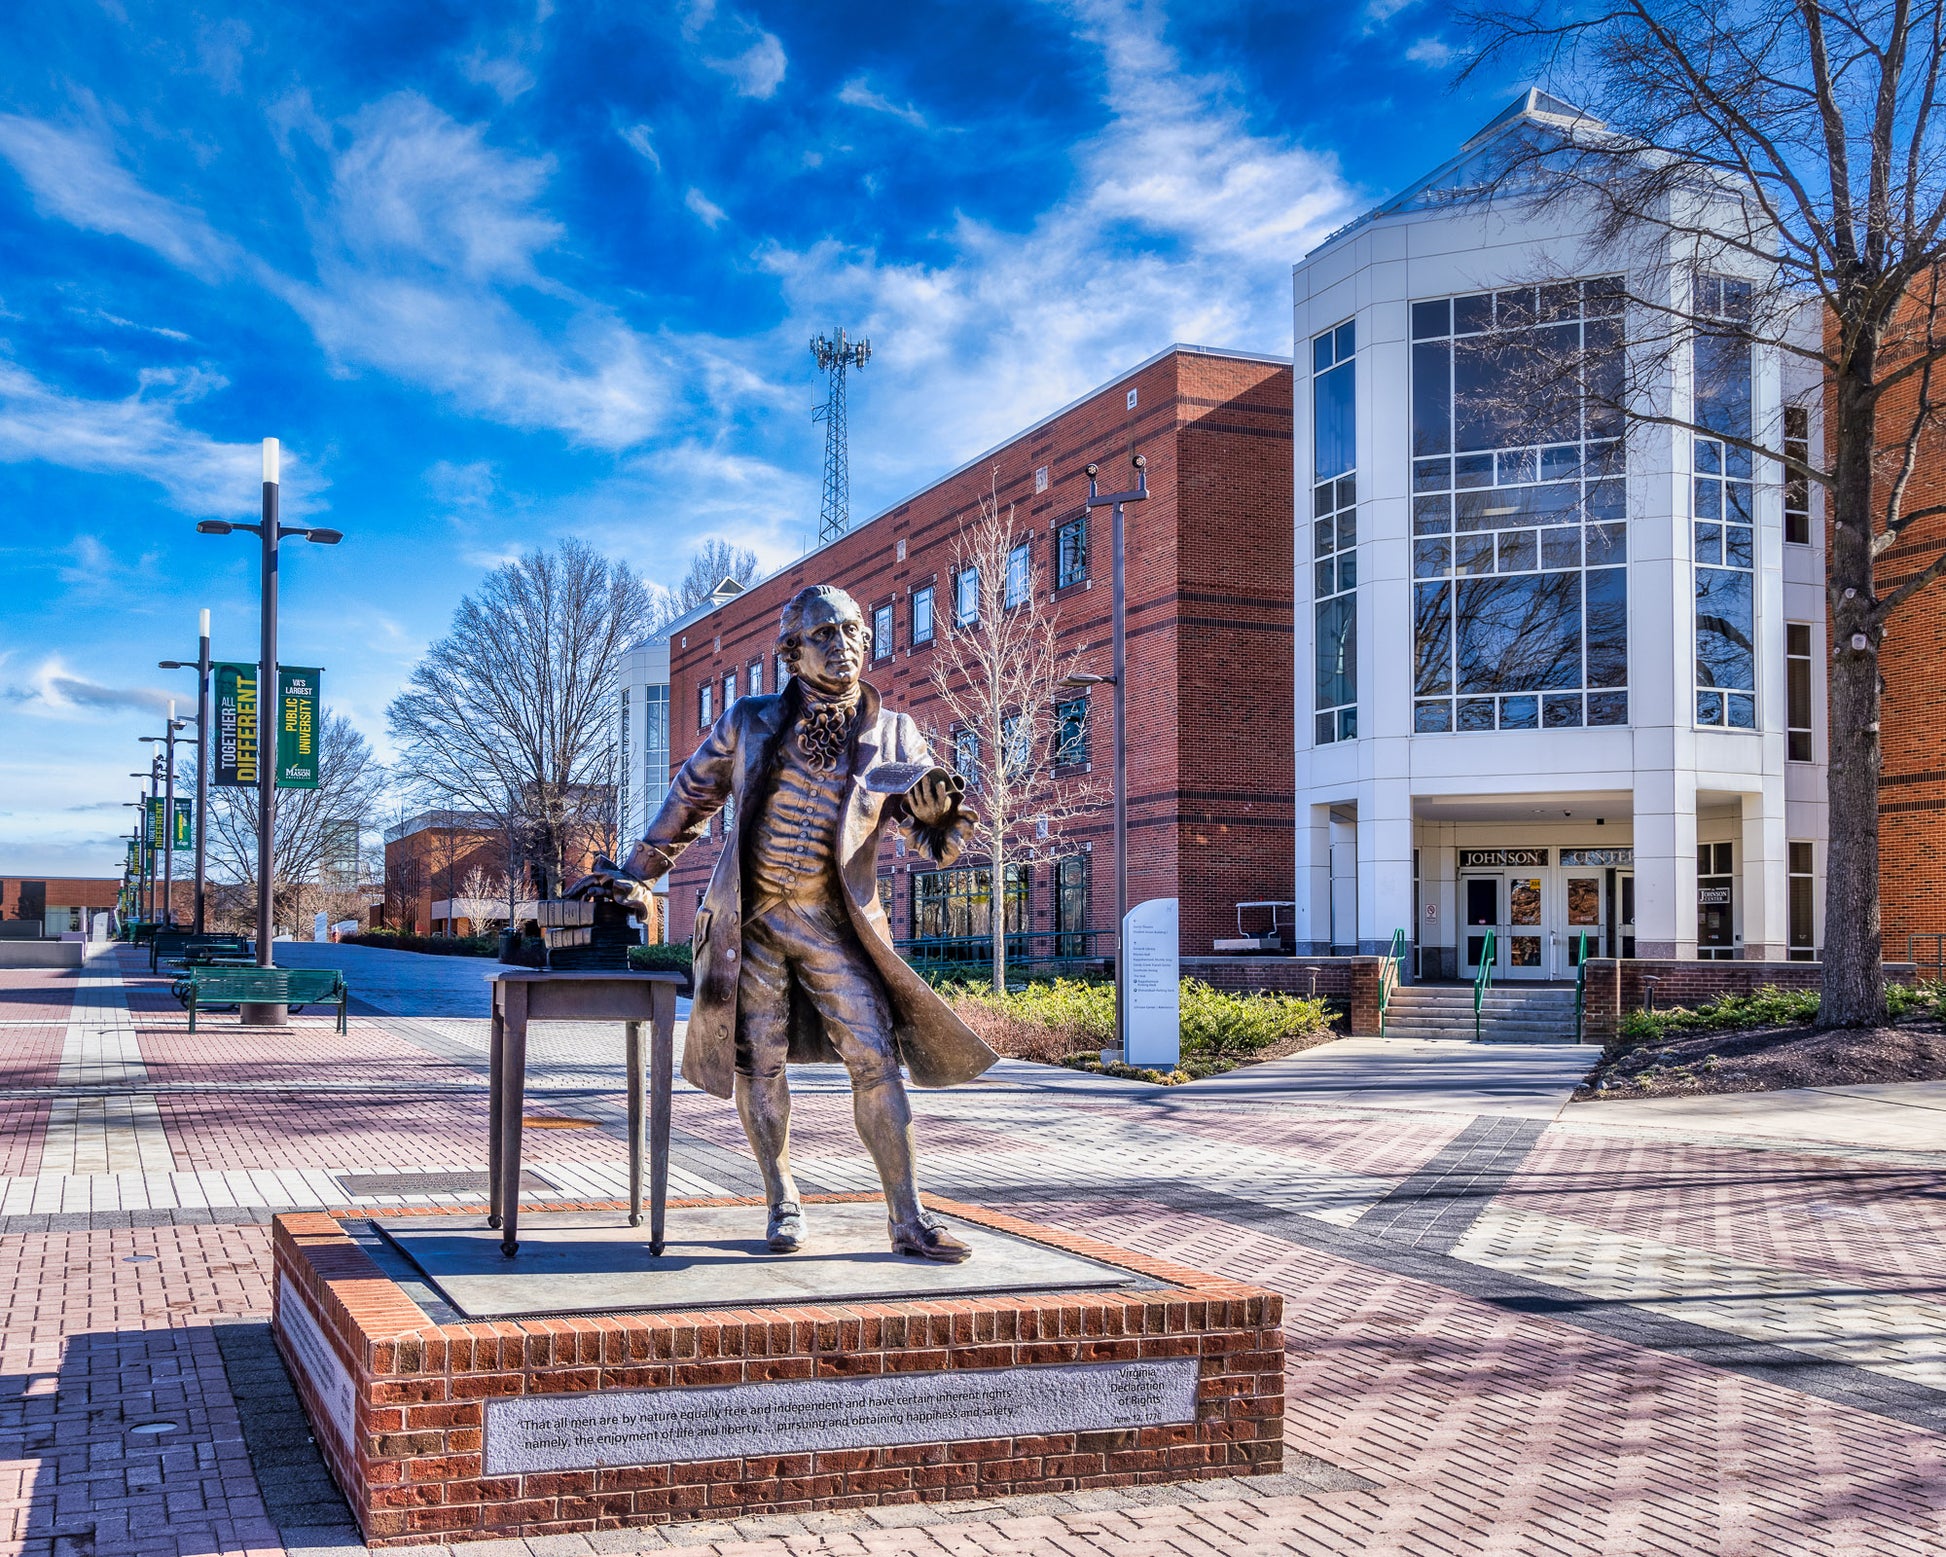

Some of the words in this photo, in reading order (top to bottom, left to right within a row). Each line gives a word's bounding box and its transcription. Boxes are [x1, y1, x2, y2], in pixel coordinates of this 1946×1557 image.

[292, 679, 306, 687] VA'S
[285, 687, 313, 696] LARGEST
[221, 696, 236, 707] ALL
[285, 697, 298, 733] PUBLIC
[236, 675, 257, 782] DIFFERENT
[299, 698, 312, 755] UNIVERSITY
[221, 708, 236, 770] TOGETHER
[155, 802, 164, 848] DIFFERENT
[1465, 852, 1539, 867] JOHNSON
[1700, 890, 1727, 902] JOHNSON
[1119, 1367, 1156, 1380] Virginia
[1110, 1381, 1165, 1393] Declaration
[1118, 1396, 1129, 1406] of
[1131, 1393, 1161, 1407] Rights
[553, 1417, 568, 1429] all
[571, 1417, 597, 1429] men
[600, 1415, 619, 1426] are
[622, 1413, 637, 1427] by
[639, 1411, 678, 1423] nature
[680, 1407, 721, 1421] equally
[724, 1405, 748, 1417] free
[750, 1403, 771, 1415] and
[774, 1400, 844, 1414] independent
[845, 1397, 866, 1409] and
[868, 1396, 895, 1408] have
[897, 1392, 934, 1406] certain
[936, 1391, 979, 1404] inherent
[982, 1388, 1012, 1401] rights
[1145, 1412, 1162, 1421] 1776
[525, 1434, 571, 1450] namely,
[575, 1433, 594, 1446] the
[597, 1430, 658, 1448] enjoyment
[661, 1428, 674, 1439] of
[676, 1427, 695, 1438] life
[697, 1425, 719, 1437] and
[721, 1423, 762, 1436] liberty,
[777, 1419, 826, 1434] pursuing
[828, 1416, 850, 1428] and
[852, 1412, 904, 1427] obtaining
[906, 1408, 958, 1426] happiness
[960, 1406, 980, 1419] and
